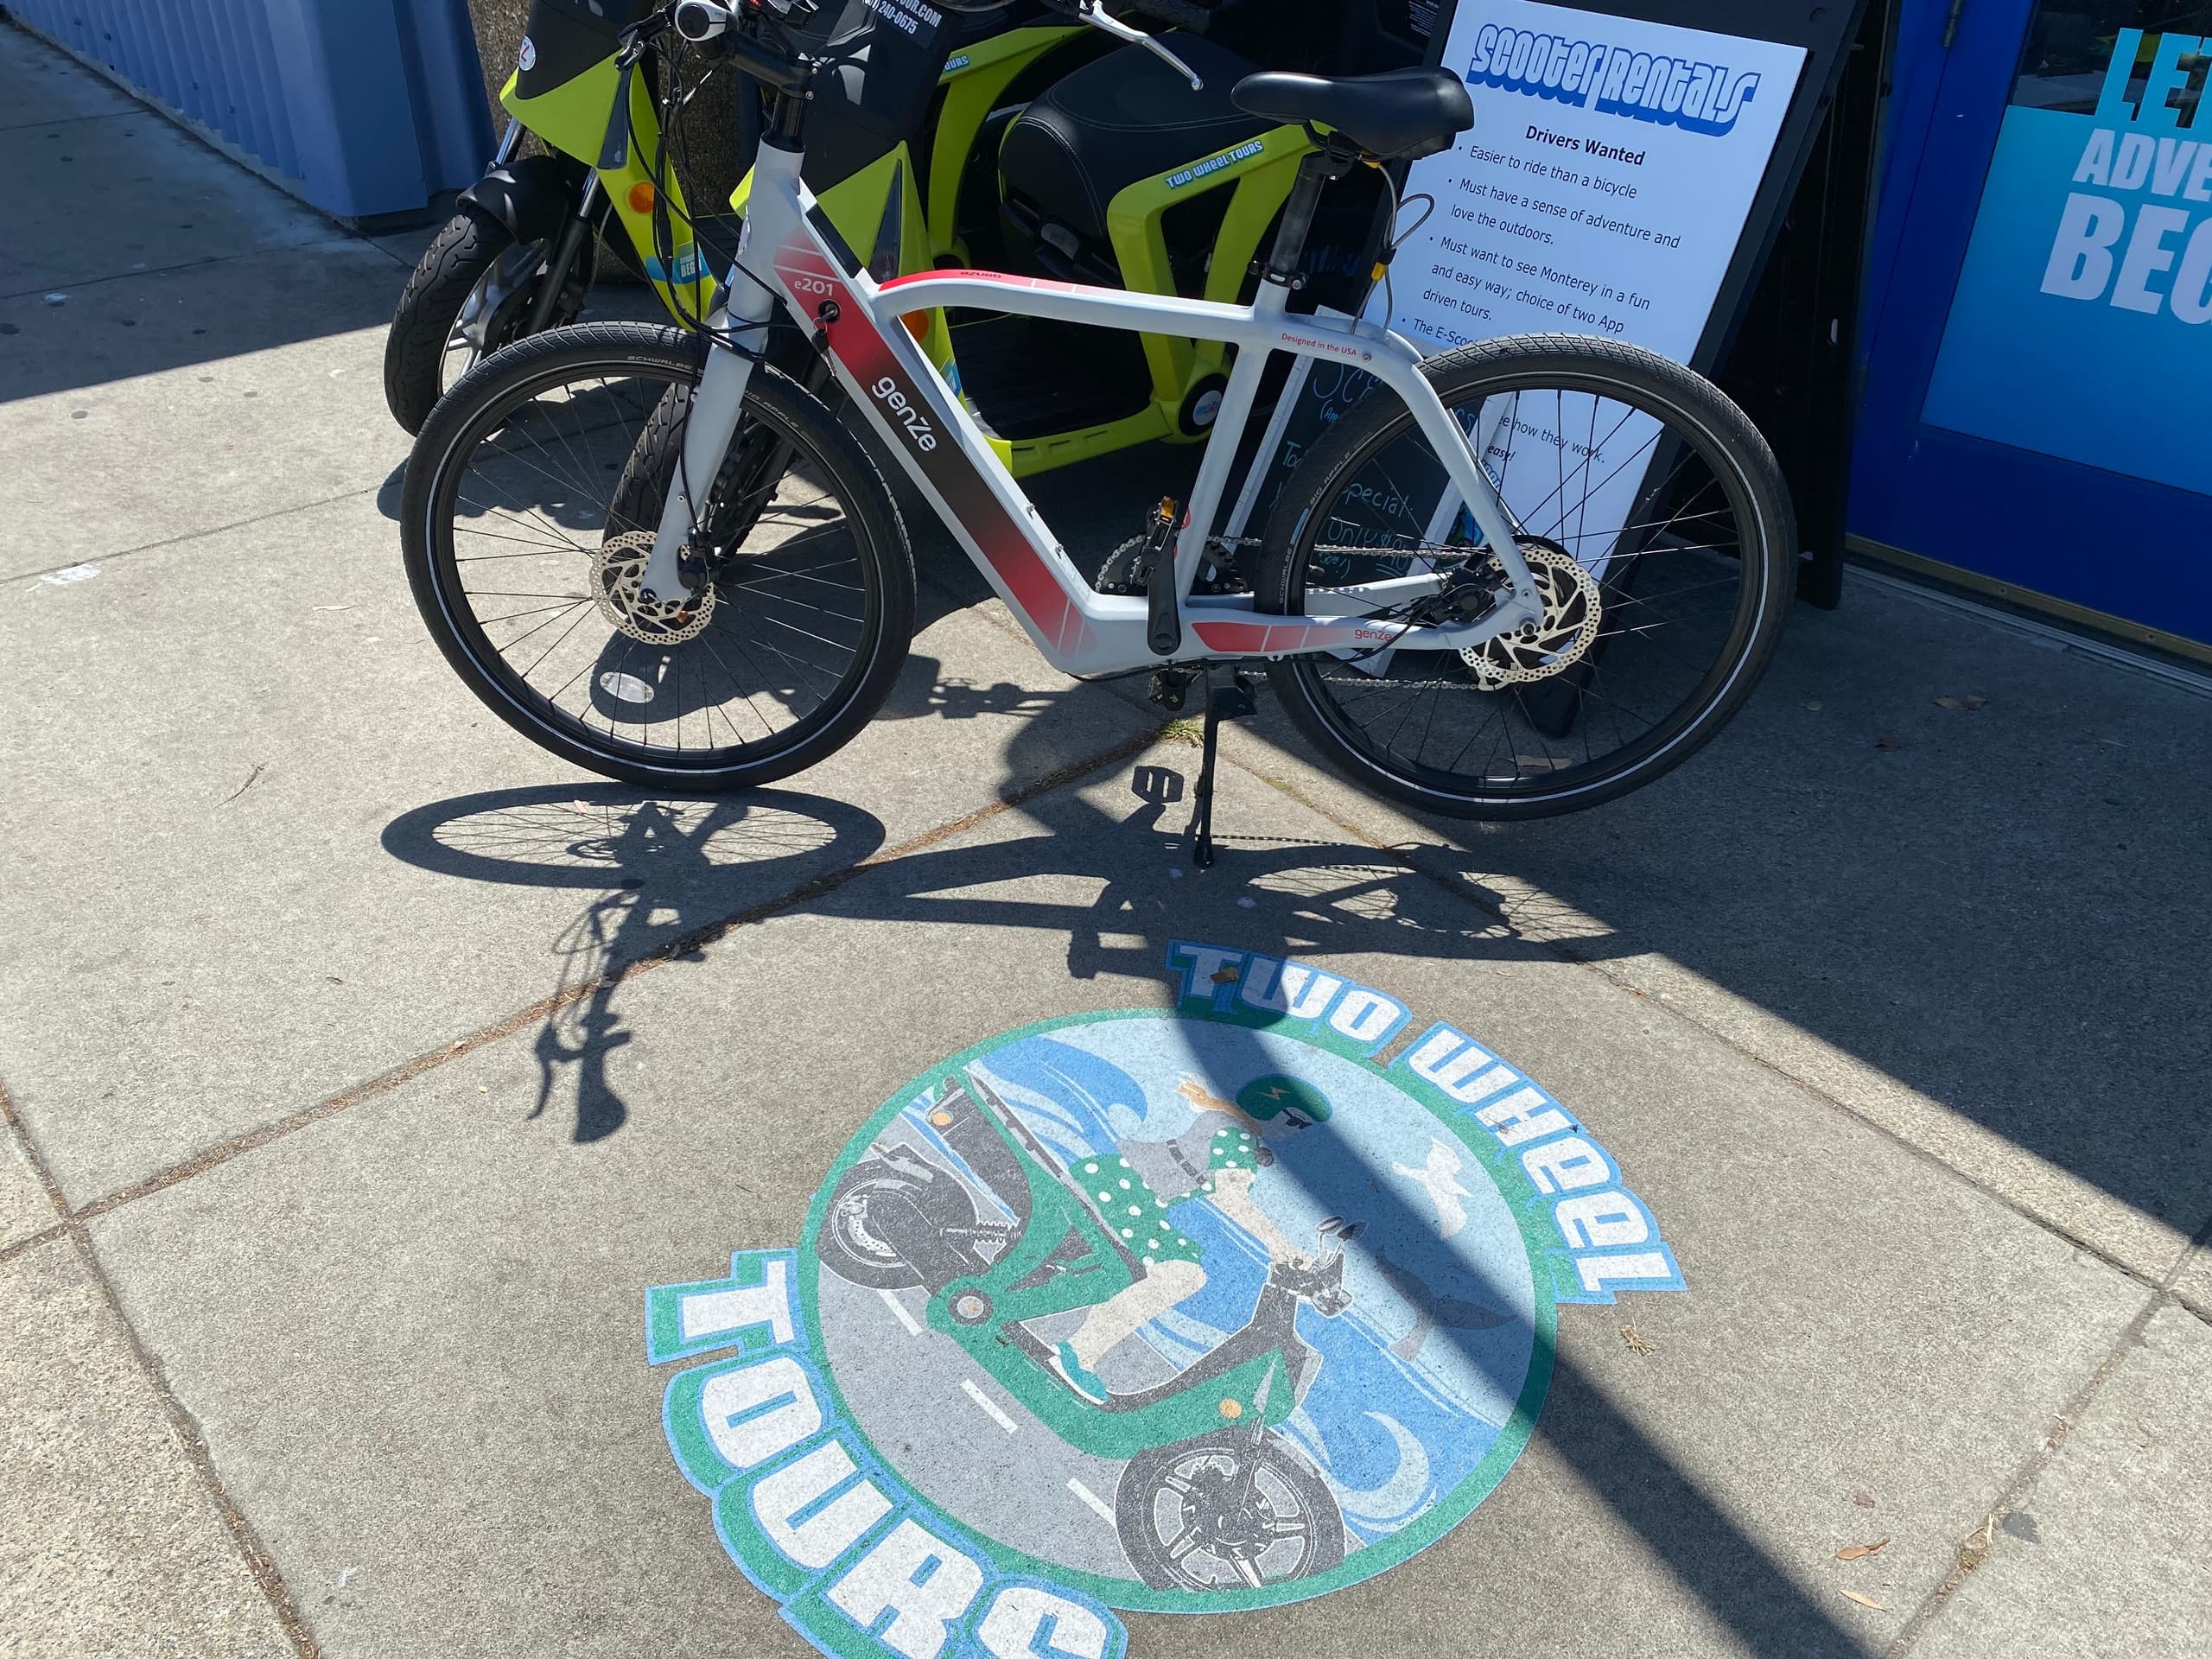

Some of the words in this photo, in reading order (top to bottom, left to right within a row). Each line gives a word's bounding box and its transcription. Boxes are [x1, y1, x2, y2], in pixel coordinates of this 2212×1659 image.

[878, 1, 918, 35] 240-0675
[944, 55, 969, 71] OURS
[1165, 169, 1192, 188] TWO
[1228, 140, 1263, 162] TOURS
[1526, 125, 1580, 150] Drivers
[1585, 139, 1646, 166] Wanted
[1470, 145, 1506, 165] Easier
[1508, 155, 1521, 169] to
[1523, 158, 1548, 176] ride
[1551, 165, 1579, 184] than
[1581, 175, 1590, 187] a
[1593, 175, 1637, 199] bicycle
[1451, 204, 1475, 221] love
[1478, 212, 1497, 228] the
[1499, 219, 1554, 245] outdoors.
[1459, 178, 1487, 196] Must
[1490, 186, 1518, 205] have
[1521, 195, 1529, 207] a
[1532, 200, 1567, 218] sense
[1570, 209, 1586, 222] of
[1586, 213, 1651, 241] adventure
[1654, 232, 1681, 249] and
[794, 277, 835, 297] e201
[1440, 236, 1469, 255] Must
[1471, 247, 1498, 264] want
[1501, 252, 1514, 269] to
[1516, 262, 1538, 276] see
[1541, 266, 1599, 296] Monterey
[1600, 284, 1613, 299] in
[1616, 291, 1625, 302] a
[1629, 293, 1651, 311] fun
[1423, 289, 1458, 309] driven
[1460, 299, 1493, 321] tours.
[1432, 263, 1454, 279] and
[1455, 272, 1482, 290] easy
[1485, 282, 1513, 299] way;
[1516, 289, 1554, 311] choice
[1556, 302, 1572, 315] of
[1573, 307, 1596, 324] two
[1598, 315, 1624, 334] App
[1281, 333, 1316, 347] Designed
[1318, 340, 1325, 349] in
[1326, 344, 1340, 353] the
[1341, 346, 1357, 356] USA
[1414, 318, 1433, 335] The
[626, 355, 692, 370] SCHWALBE
[1487, 444, 1516, 461] easy!
[1513, 418, 1539, 437] how
[1541, 429, 1568, 449] they
[1572, 443, 1605, 463] work.
[1173, 942, 1408, 1047] TWO
